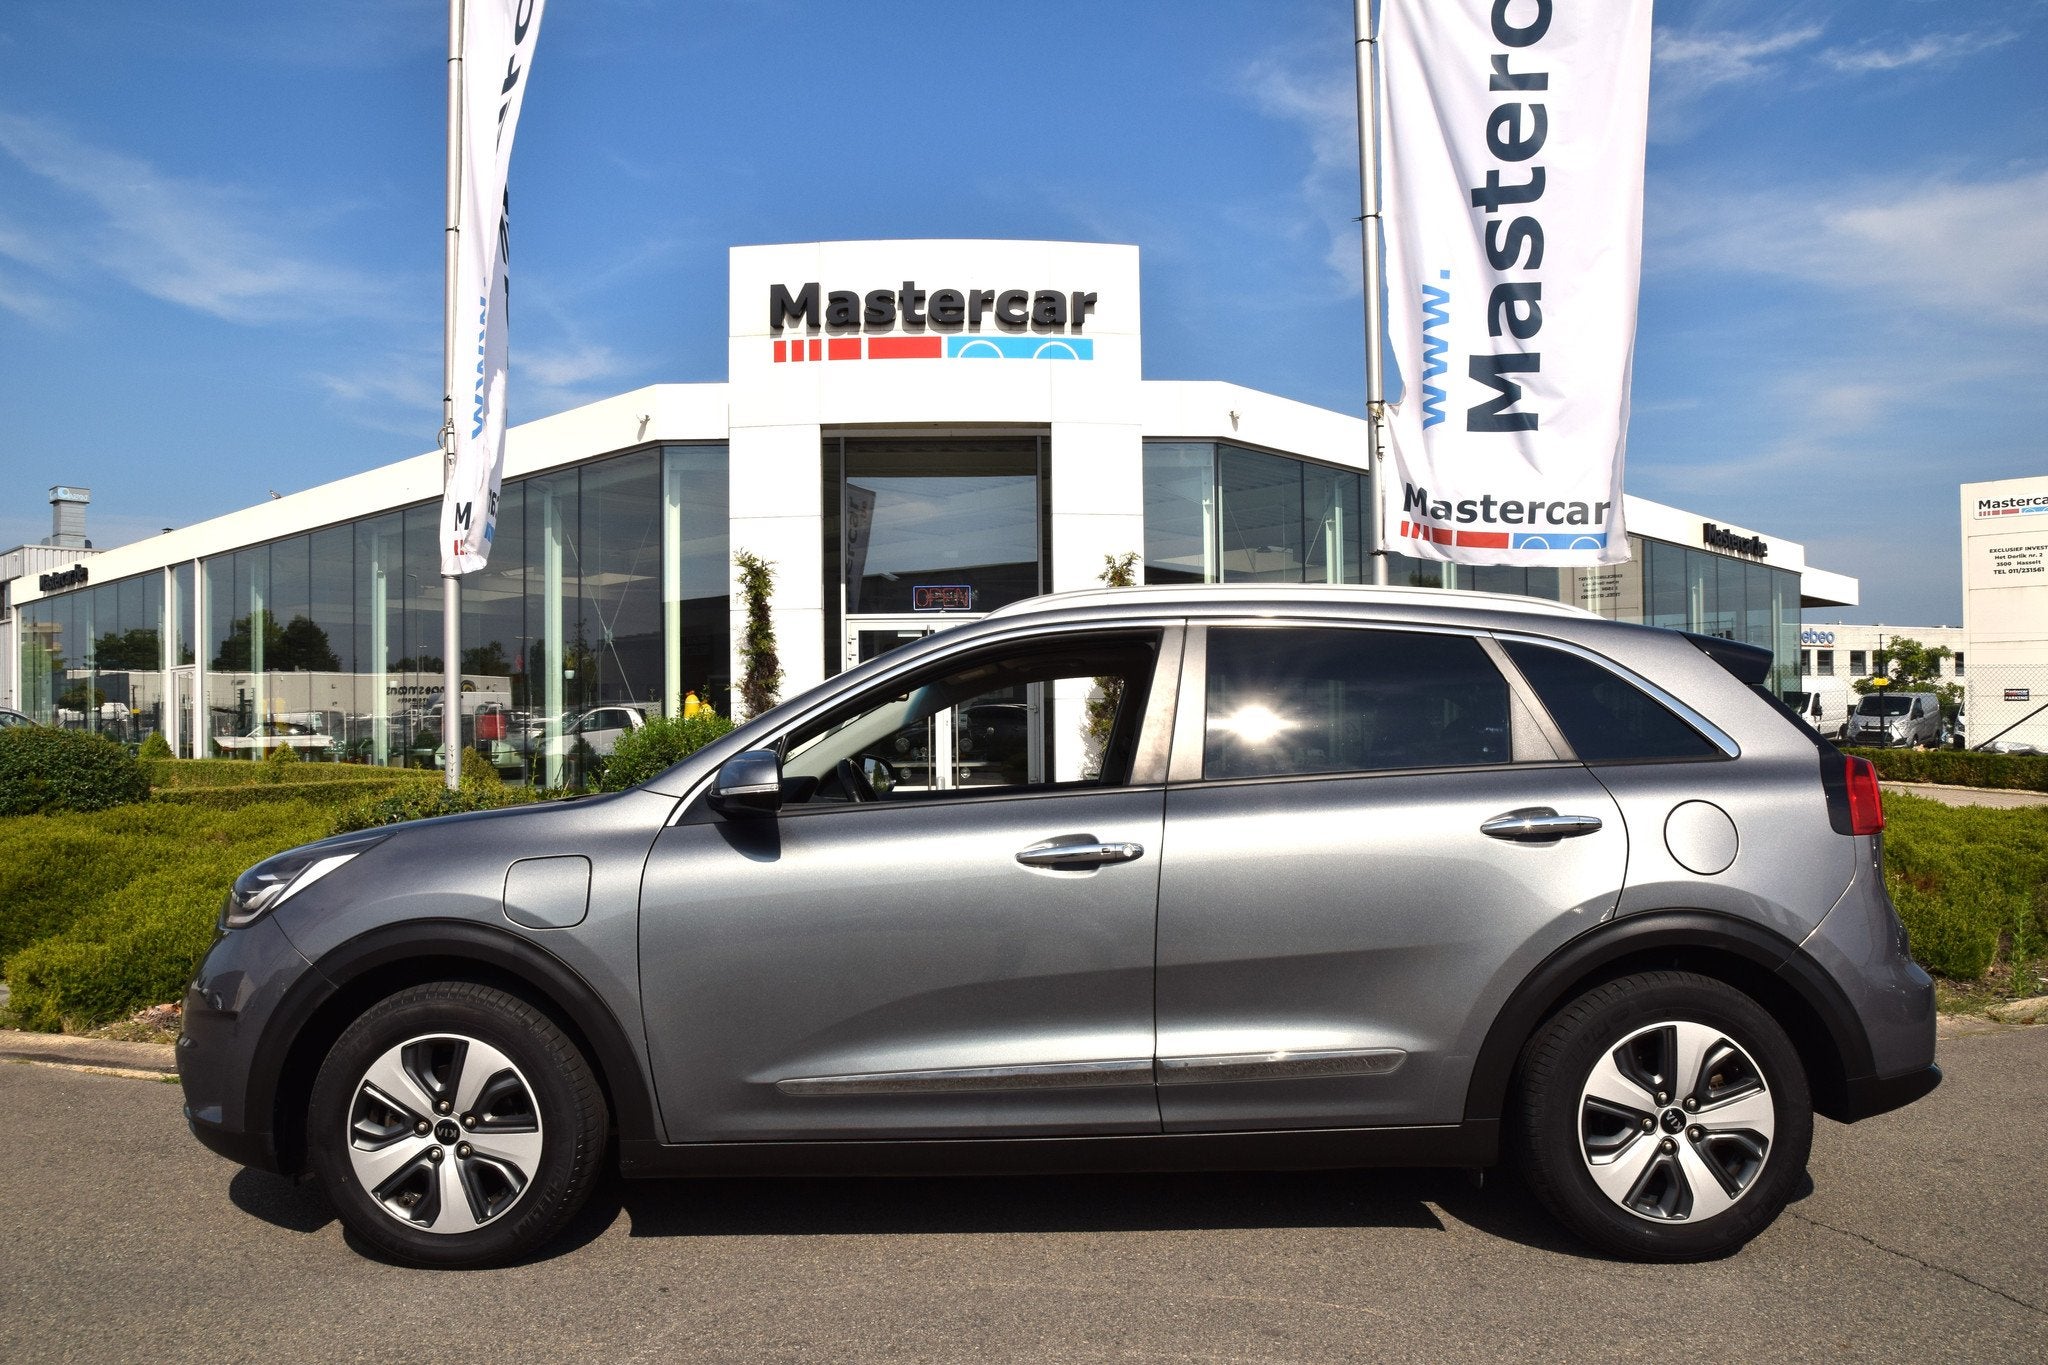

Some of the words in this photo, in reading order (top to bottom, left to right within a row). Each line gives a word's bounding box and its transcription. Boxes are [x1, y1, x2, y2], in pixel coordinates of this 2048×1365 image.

[770, 280, 1097, 329] Mastercar
[1403, 482, 1611, 526] Mastercar
[916, 587, 969, 608] OPEN
[436, 1126, 457, 1138] KIA
[1665, 1110, 1683, 1132] KIA
